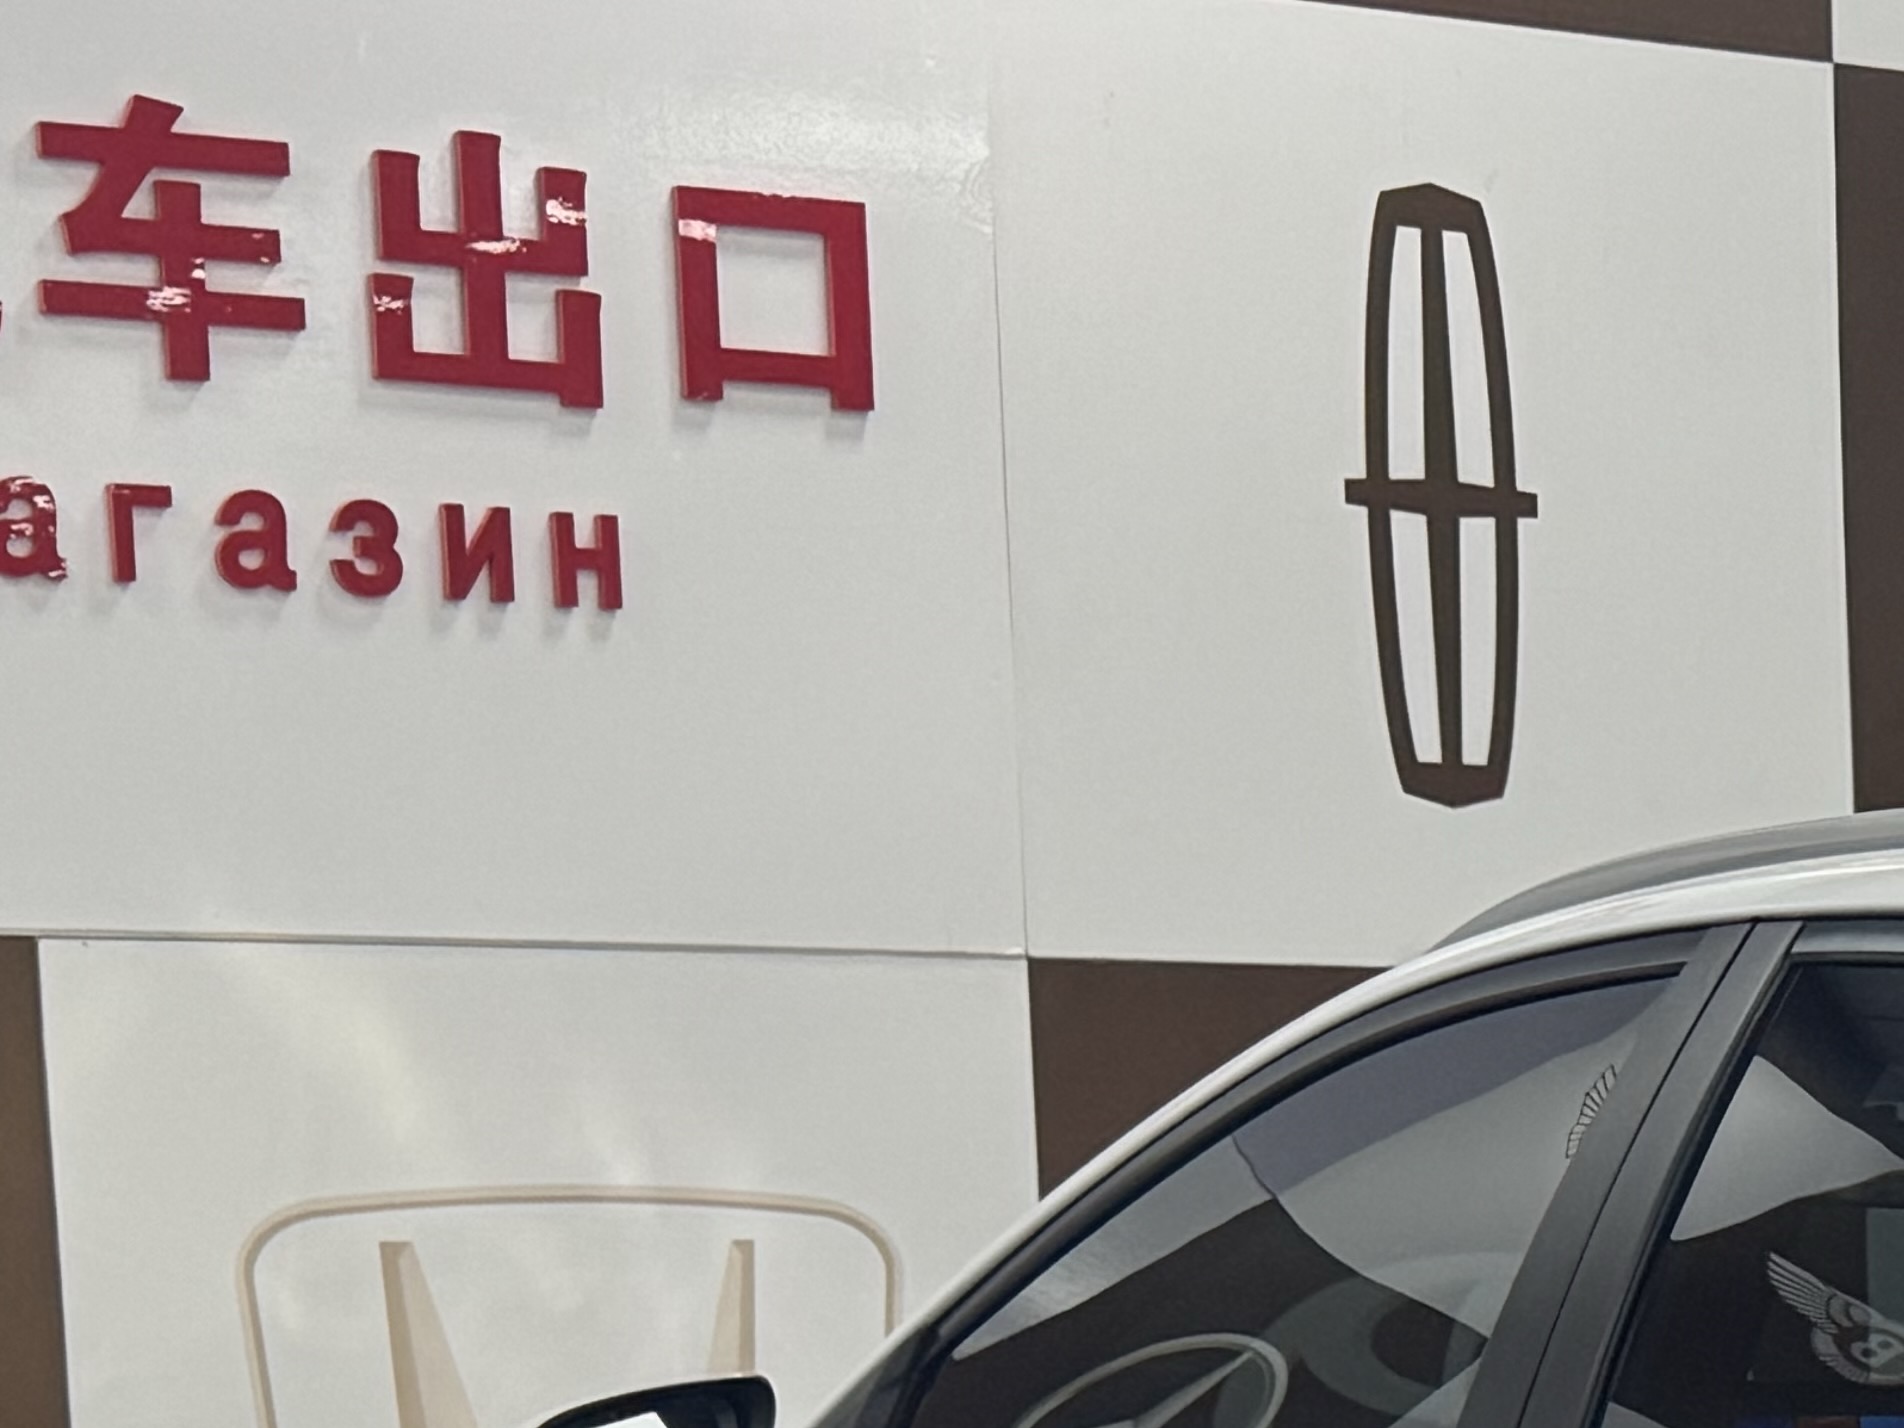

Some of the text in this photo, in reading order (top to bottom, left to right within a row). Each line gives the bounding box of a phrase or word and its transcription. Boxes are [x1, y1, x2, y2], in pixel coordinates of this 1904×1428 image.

[0, 95, 875, 412] 车出口
[0, 475, 622, 610] агазин
